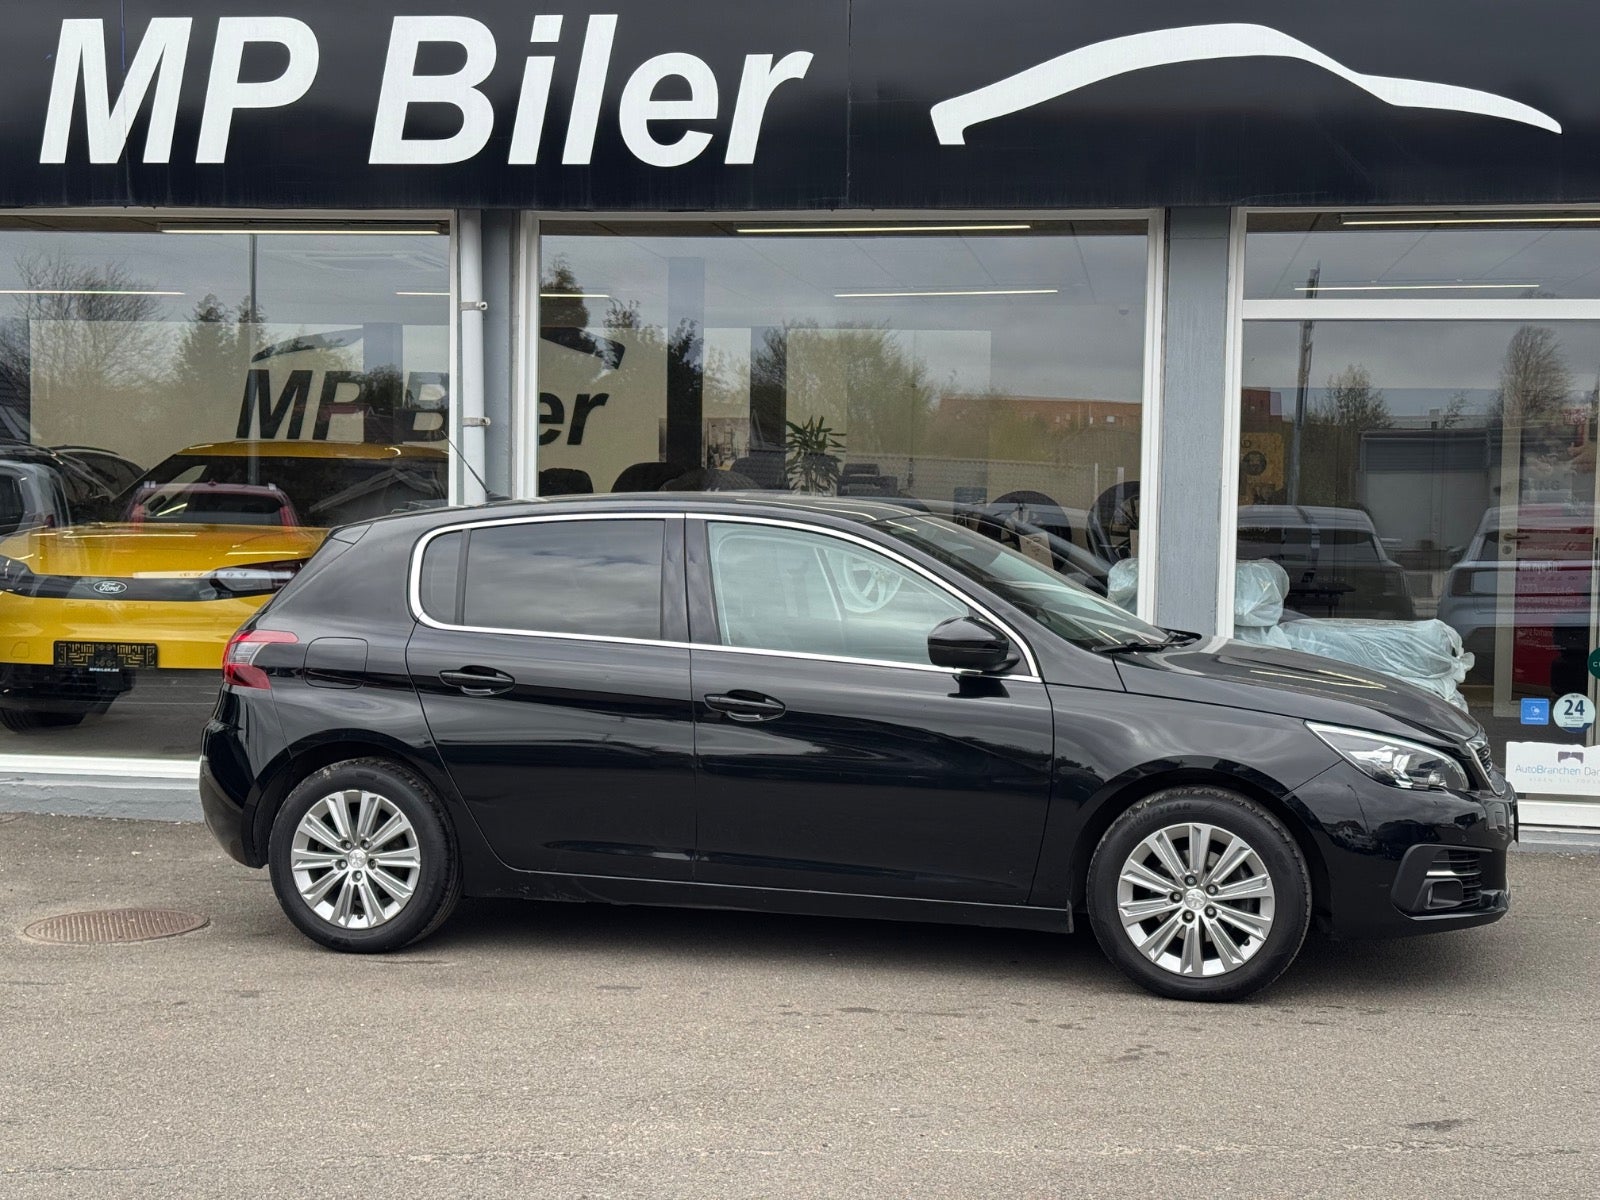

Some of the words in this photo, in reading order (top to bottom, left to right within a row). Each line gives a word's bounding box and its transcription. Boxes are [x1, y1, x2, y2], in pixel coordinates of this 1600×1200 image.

[39, 16, 320, 165] MP
[368, 14, 814, 168] Biler
[99, 582, 121, 592] Ford
[1563, 699, 1585, 716] 24
[1515, 764, 1581, 775] AutoBranchen
